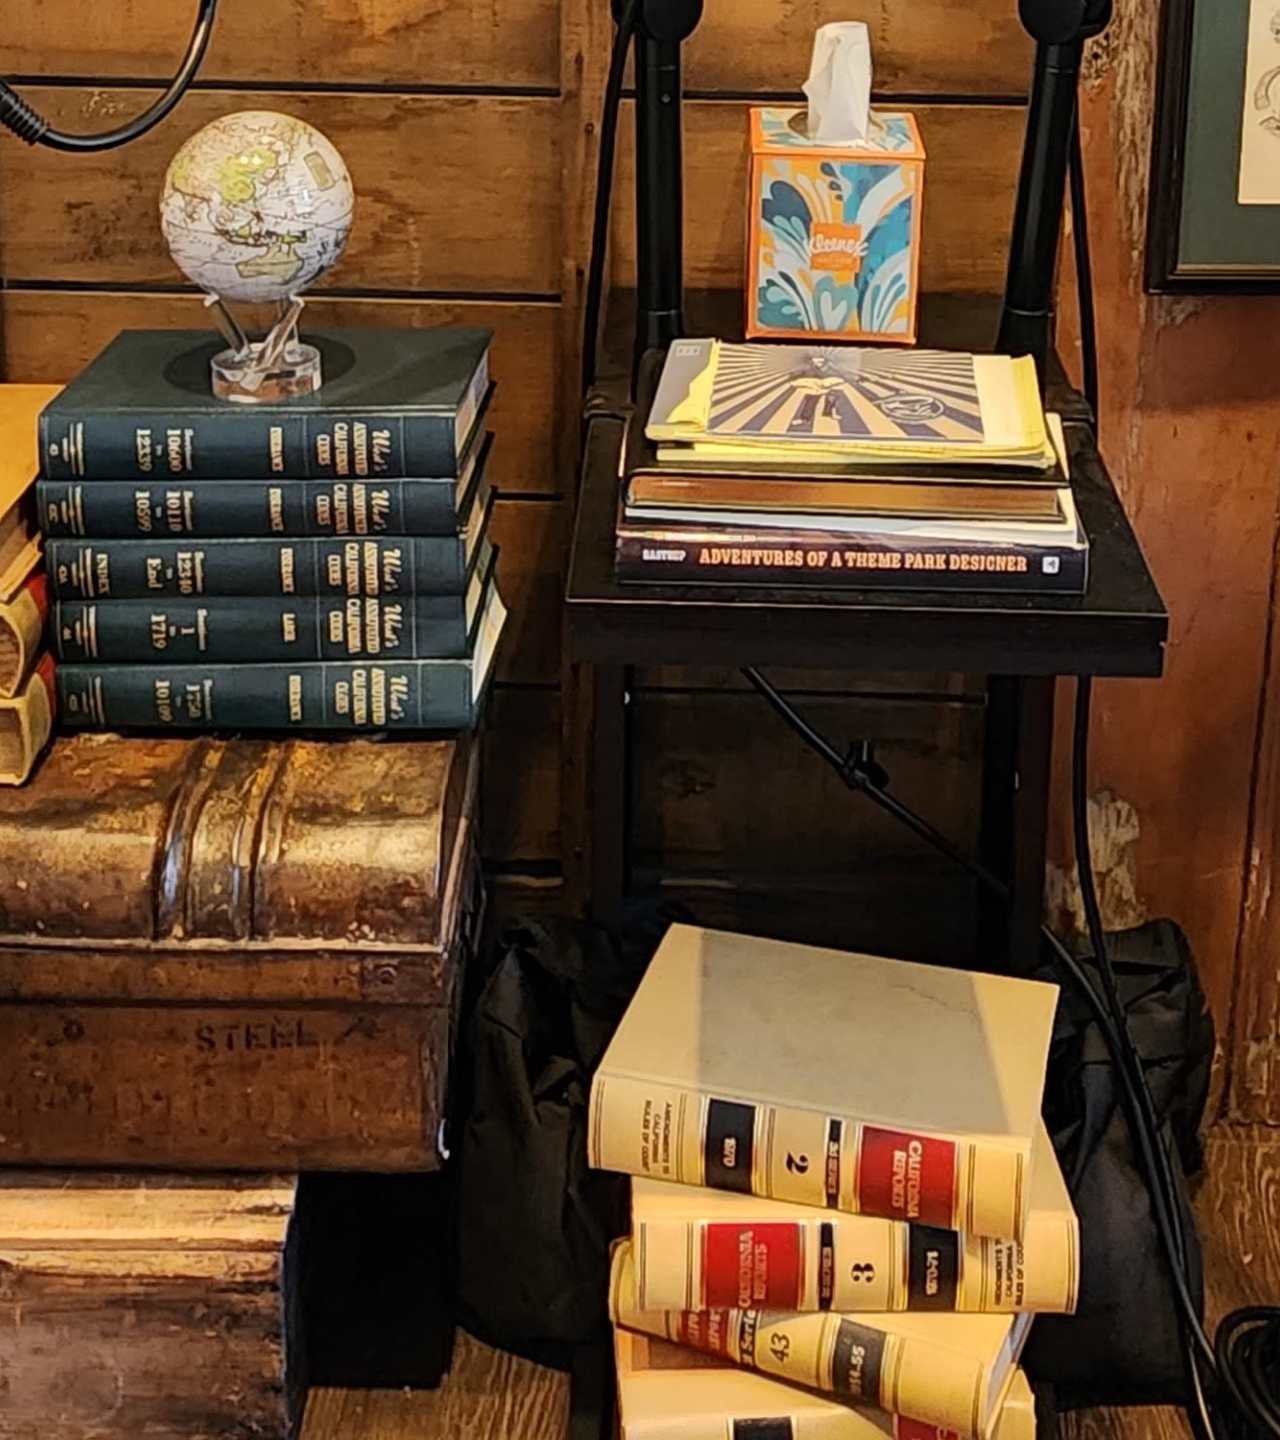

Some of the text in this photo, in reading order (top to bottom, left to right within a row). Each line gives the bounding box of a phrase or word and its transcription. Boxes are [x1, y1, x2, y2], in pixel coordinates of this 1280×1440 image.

[810, 233, 869, 257] Kleenex
[146, 558, 163, 589] End
[698, 547, 804, 567] ADVENTURES
[806, 550, 827, 567] OF
[830, 551, 842, 568] A
[844, 551, 903, 570] THEME
[904, 553, 947, 571] PARK
[948, 554, 1028, 572] DESIGNER
[151, 614, 168, 649] 1719
[194, 1017, 320, 1051] STEEL
[785, 1151, 810, 1175] 2
[891, 1149, 907, 1209] REPORTS
[906, 1139, 923, 1219] CALIFORNIA
[738, 1229, 754, 1309] CALIFORNIA
[753, 1242, 767, 1300] REPORTS
[850, 1262, 876, 1284] 3
[740, 1310, 757, 1351] Serie
[769, 1332, 791, 1363] 43
